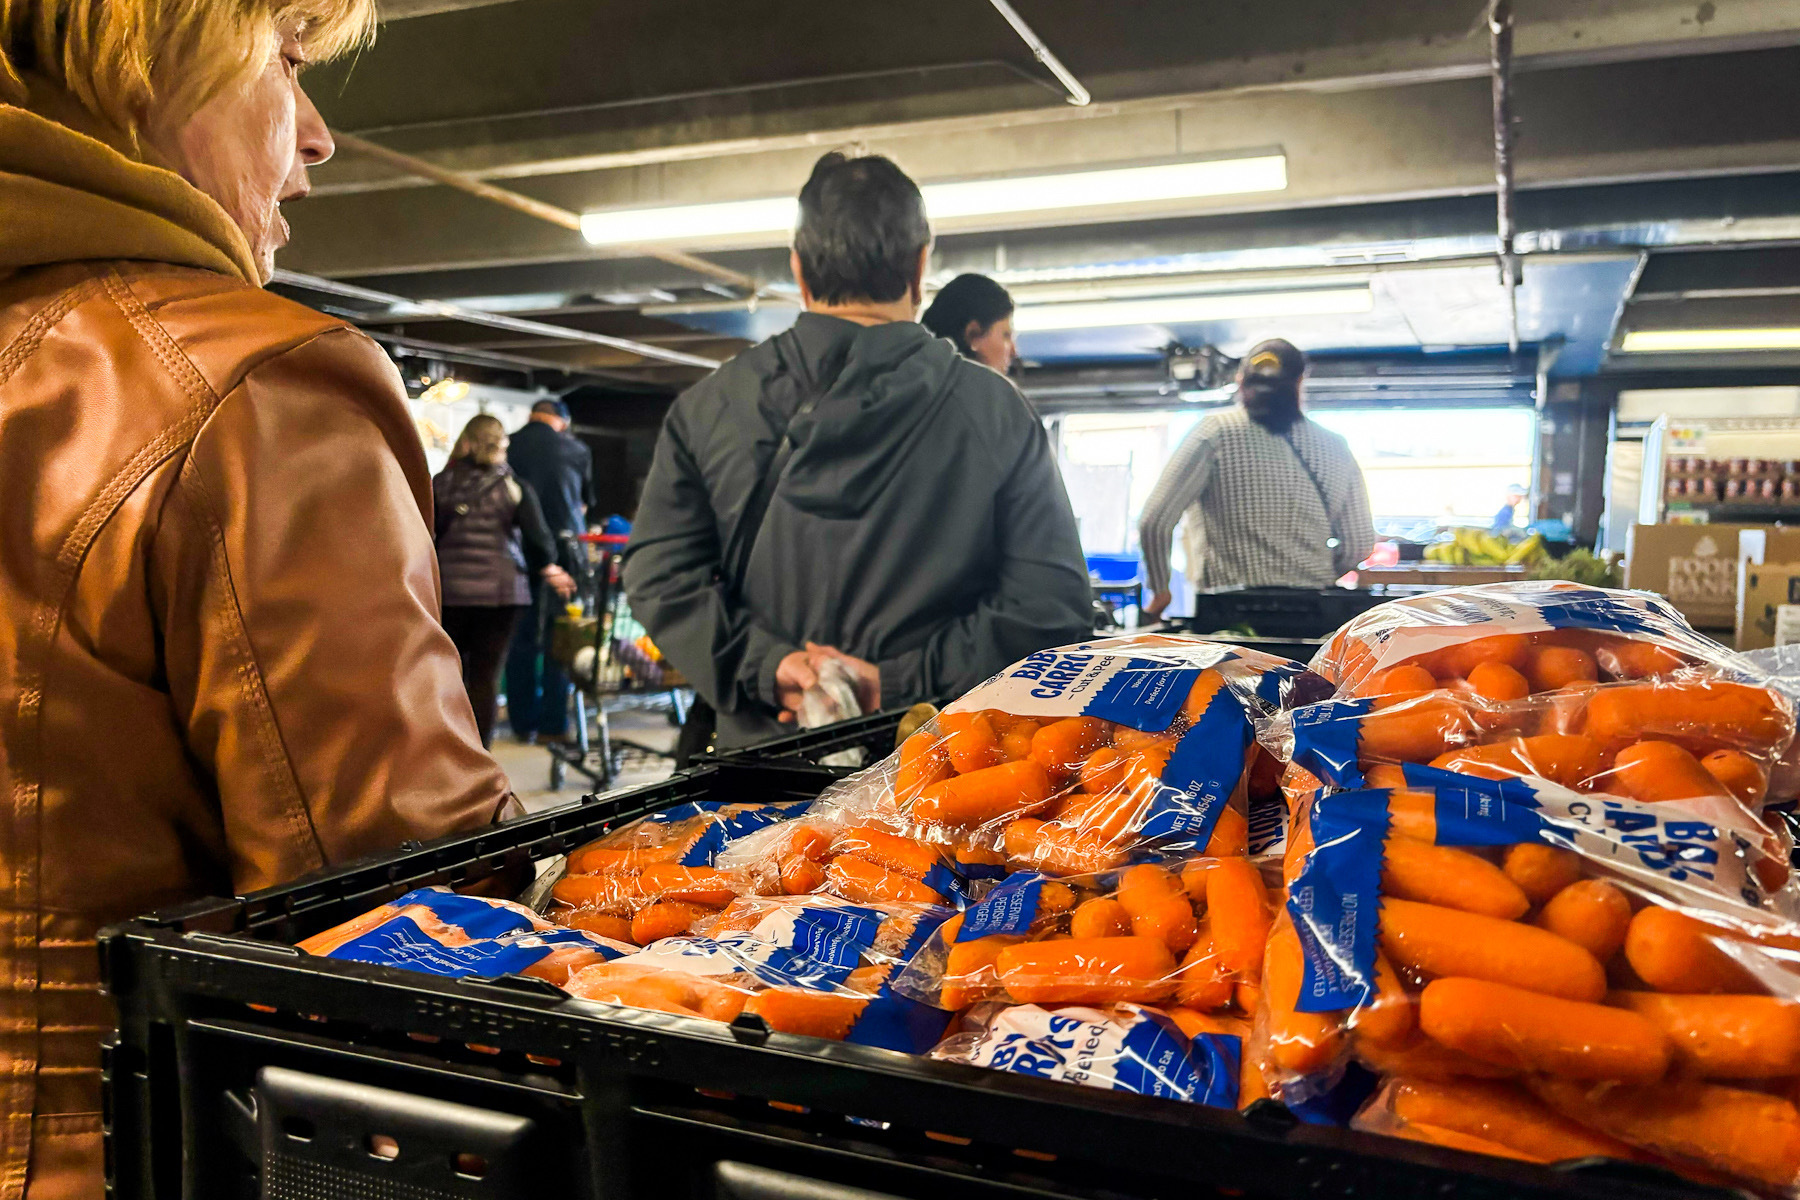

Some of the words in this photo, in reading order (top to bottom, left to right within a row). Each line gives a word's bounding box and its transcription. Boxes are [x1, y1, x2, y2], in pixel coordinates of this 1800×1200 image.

[1669, 557, 1736, 575] FOOD
[1190, 780, 1204, 793] OZ
[1341, 893, 1358, 908] NO
[1158, 1049, 1174, 1065] Eat
